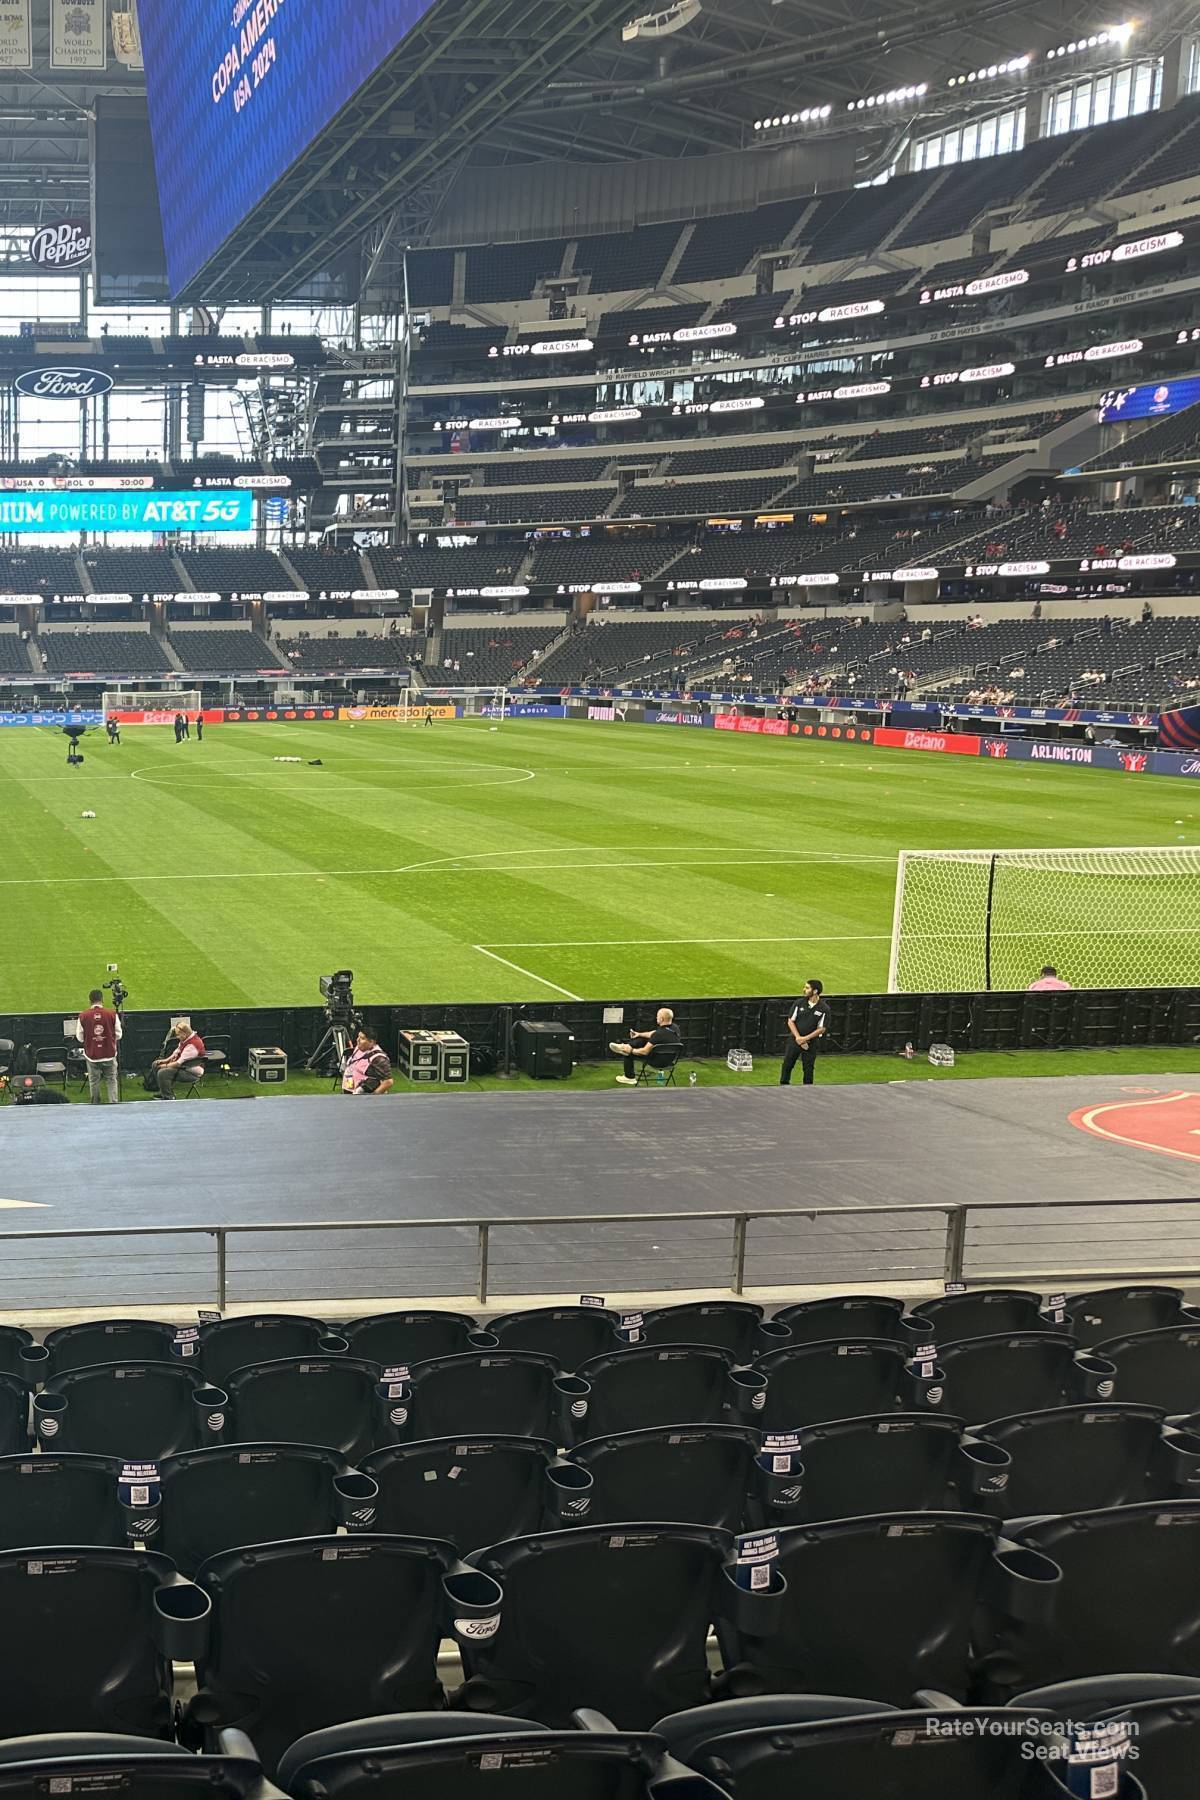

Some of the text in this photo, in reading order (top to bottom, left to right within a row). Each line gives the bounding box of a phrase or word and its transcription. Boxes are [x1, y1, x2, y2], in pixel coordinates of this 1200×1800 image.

[55, 47, 101, 56] CHAMPIONS
[213, 44, 240, 103] COPA
[234, 37, 276, 113] USA 2024
[57, 224, 82, 245] Dr
[1081, 237, 1167, 267] STOP RACISM
[934, 273, 1024, 300] BASTA DE RACISMO
[1113, 292, 1136, 303] WHITE
[789, 303, 869, 326] STOP RACISM
[643, 332, 671, 343] BASTA
[692, 325, 732, 338] RACISMO
[958, 325, 981, 336] HAYES
[503, 341, 580, 355] STOP RACISM
[805, 350, 829, 360] HARRIS
[1056, 342, 1138, 364] BASTA DE RACISMO
[208, 355, 291, 364] BASTA DE RACISMO
[650, 368, 676, 378] WRIGHT
[933, 366, 1003, 384] STOP RACISM
[33, 371, 96, 394] Ford
[807, 383, 887, 401] BASTA DE RACISMO
[685, 400, 752, 414] STOP RACISM
[17, 477, 45, 487] USA 0
[67, 477, 95, 487] BOL 0
[120, 476, 145, 487] 30:00
[206, 476, 287, 486] BASTA DE RACISMO
[51, 504, 117, 520] POWERED
[123, 503, 138, 520] BY
[142, 502, 200, 522] AT&T
[202, 502, 240, 521] 5G
[976, 563, 1038, 576] STOP RACISM
[1092, 556, 1171, 569] BASTA DE RACISMO
[32, 715, 66, 724] BYD
[370, 708, 420, 718] mercado
[588, 707, 615, 721] PUMA
[683, 714, 702, 724] ULTRA
[904, 732, 945, 750] Betano
[1031, 744, 1092, 763] ARLINGTON
